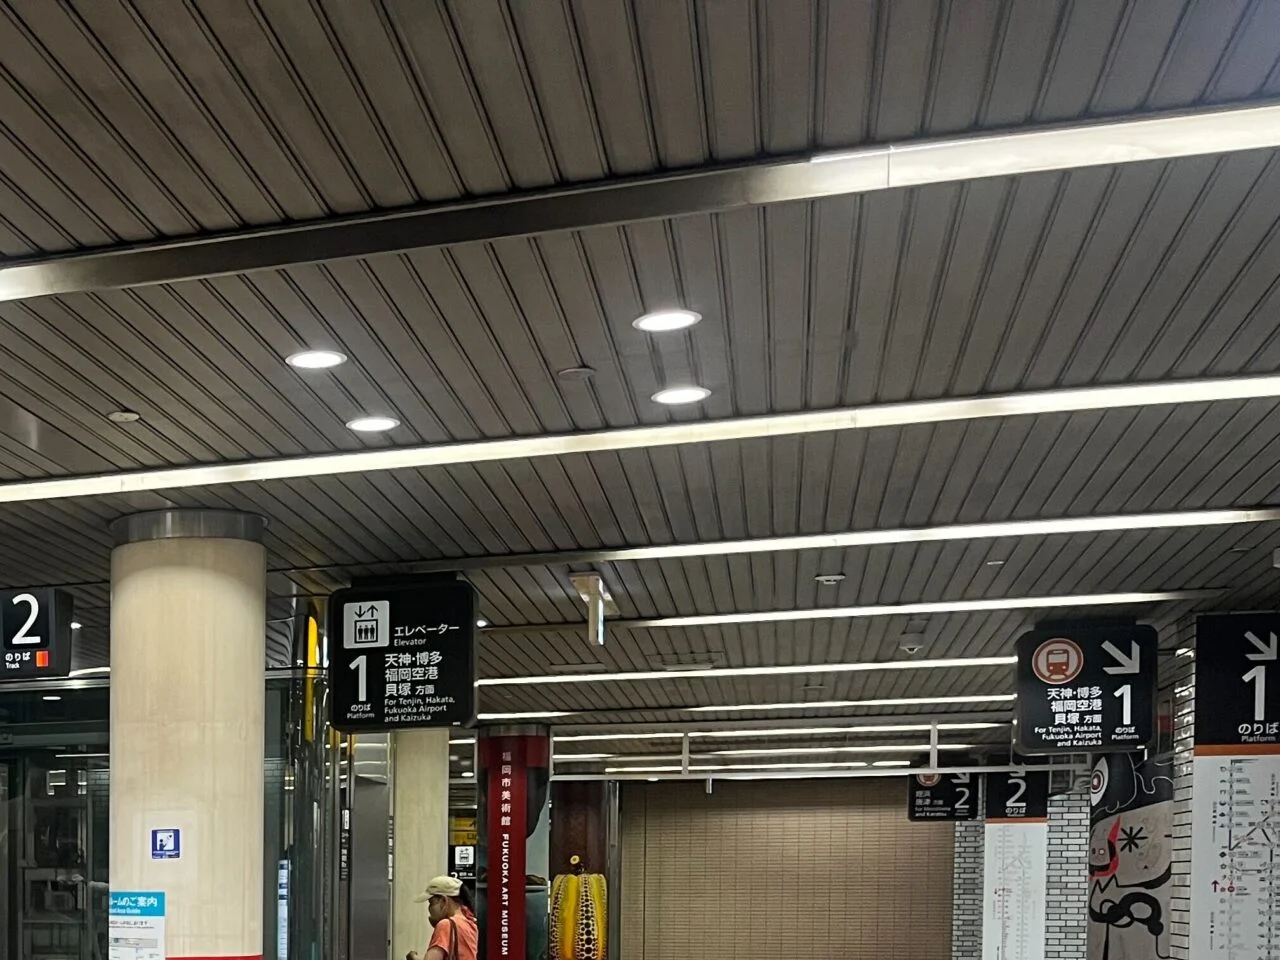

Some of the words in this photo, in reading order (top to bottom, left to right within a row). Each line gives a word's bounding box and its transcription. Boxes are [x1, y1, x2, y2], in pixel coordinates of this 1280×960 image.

[12, 593, 41, 645] 2
[394, 623, 460, 637] エレベーター
[394, 639, 427, 647] Elevator
[5, 651, 31, 662] のりば
[348, 655, 367, 702] 1
[384, 667, 439, 682] 福岡空港
[384, 683, 411, 697] 貝塚
[415, 684, 435, 695] 方面
[1242, 665, 1265, 721] 1
[426, 696, 455, 704] Hakata,
[1051, 699, 1102, 712] 福岡空港
[1113, 684, 1131, 725] 1
[350, 703, 371, 712] のりば
[384, 706, 417, 714] Fukuoka
[419, 705, 447, 713] Airport
[401, 714, 431, 722] Kaizuka
[1054, 713, 1080, 725] 貝塚
[1083, 714, 1102, 723] 方面
[1115, 726, 1135, 734] のりば
[1238, 722, 1279, 734] のりば
[1075, 732, 1102, 740] Airport
[501, 751, 512, 826] 福岡市美術館
[1005, 778, 1027, 807] 2
[954, 787, 970, 809] 2
[501, 833, 510, 885] FUKUOKA
[501, 887, 509, 906] ART
[501, 909, 509, 956] MUSEUM
